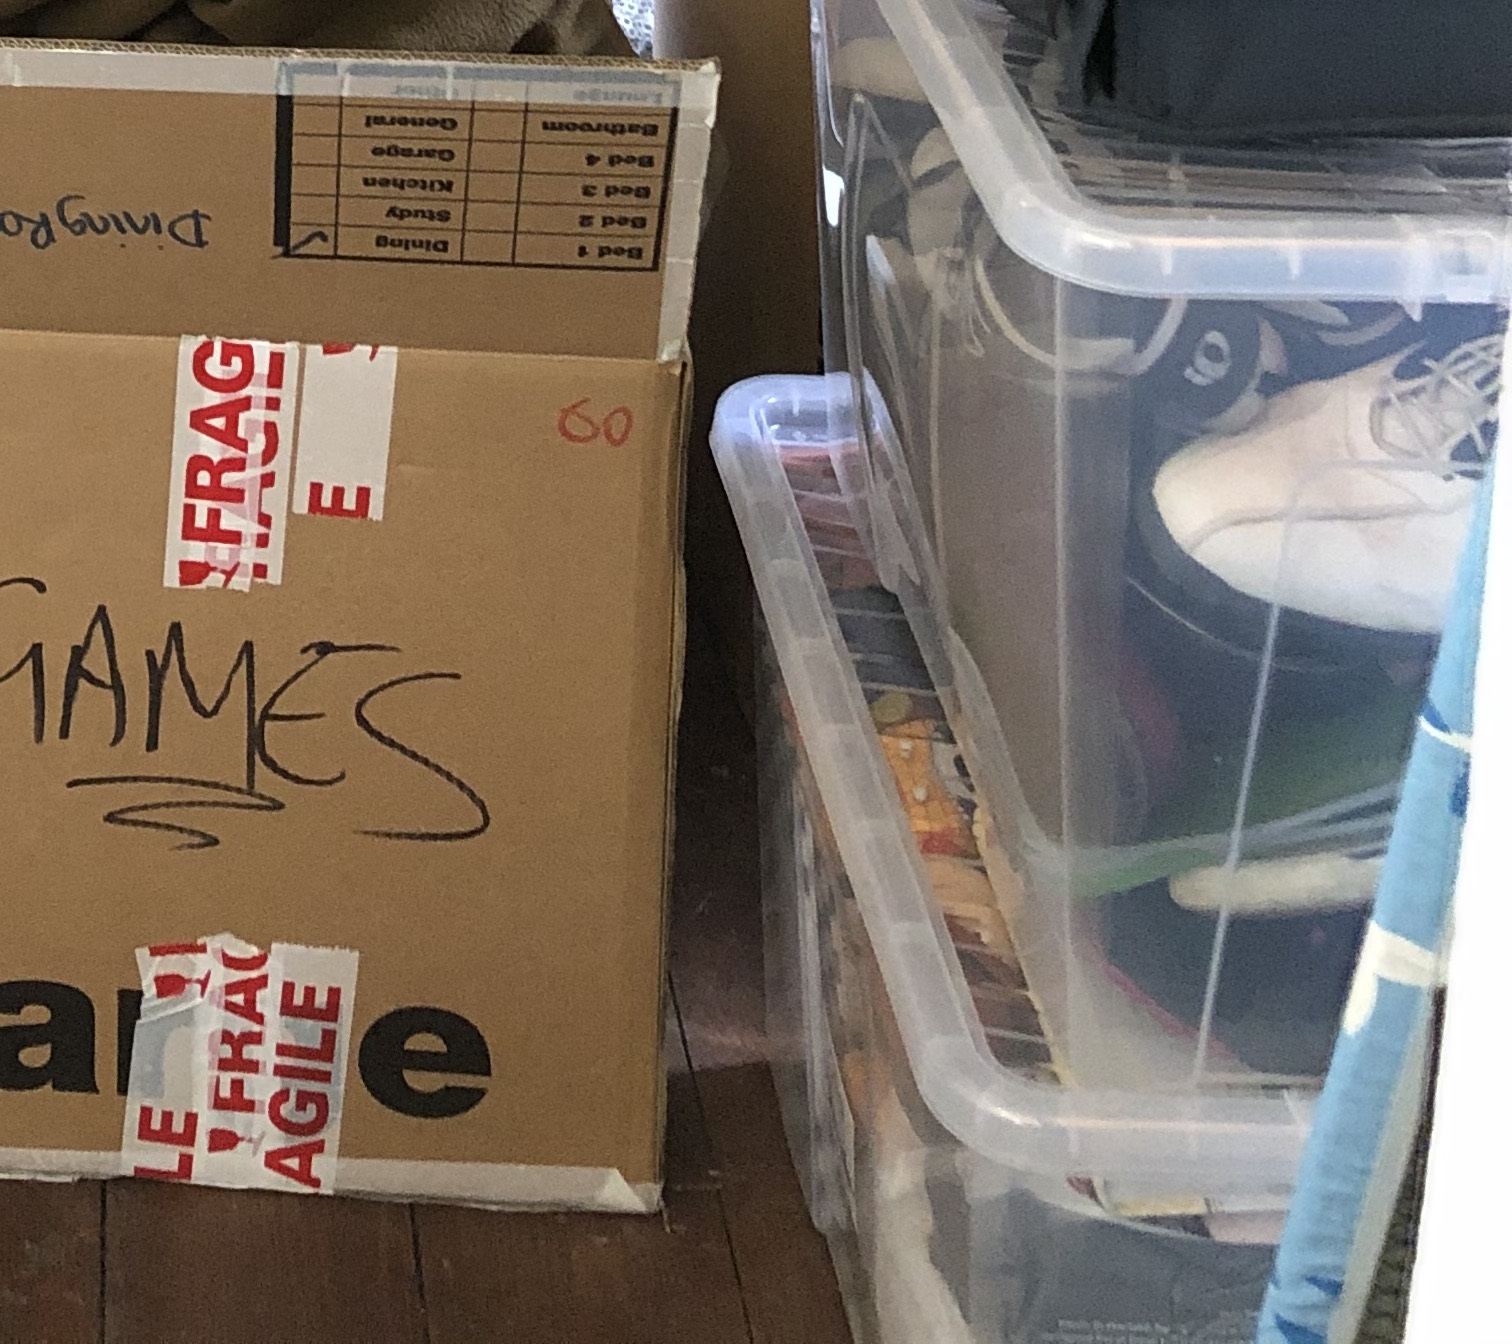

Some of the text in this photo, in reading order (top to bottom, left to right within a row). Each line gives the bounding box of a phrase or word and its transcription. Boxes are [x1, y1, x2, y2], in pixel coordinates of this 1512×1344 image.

[364, 114, 458, 131] General
[541, 119, 659, 137] Bathroom
[370, 145, 455, 162] Garage
[585, 153, 655, 169] Bed 4
[362, 176, 454, 193] Kitchen
[605, 184, 652, 199] Bed
[55, 195, 212, 250] Dining
[385, 205, 452, 223] Study
[601, 214, 648, 229] Bed
[375, 237, 450, 254] Dining
[577, 244, 644, 260] Bed 1
[181, 340, 256, 546] FRAG
[263, 980, 343, 1188] AGILE
